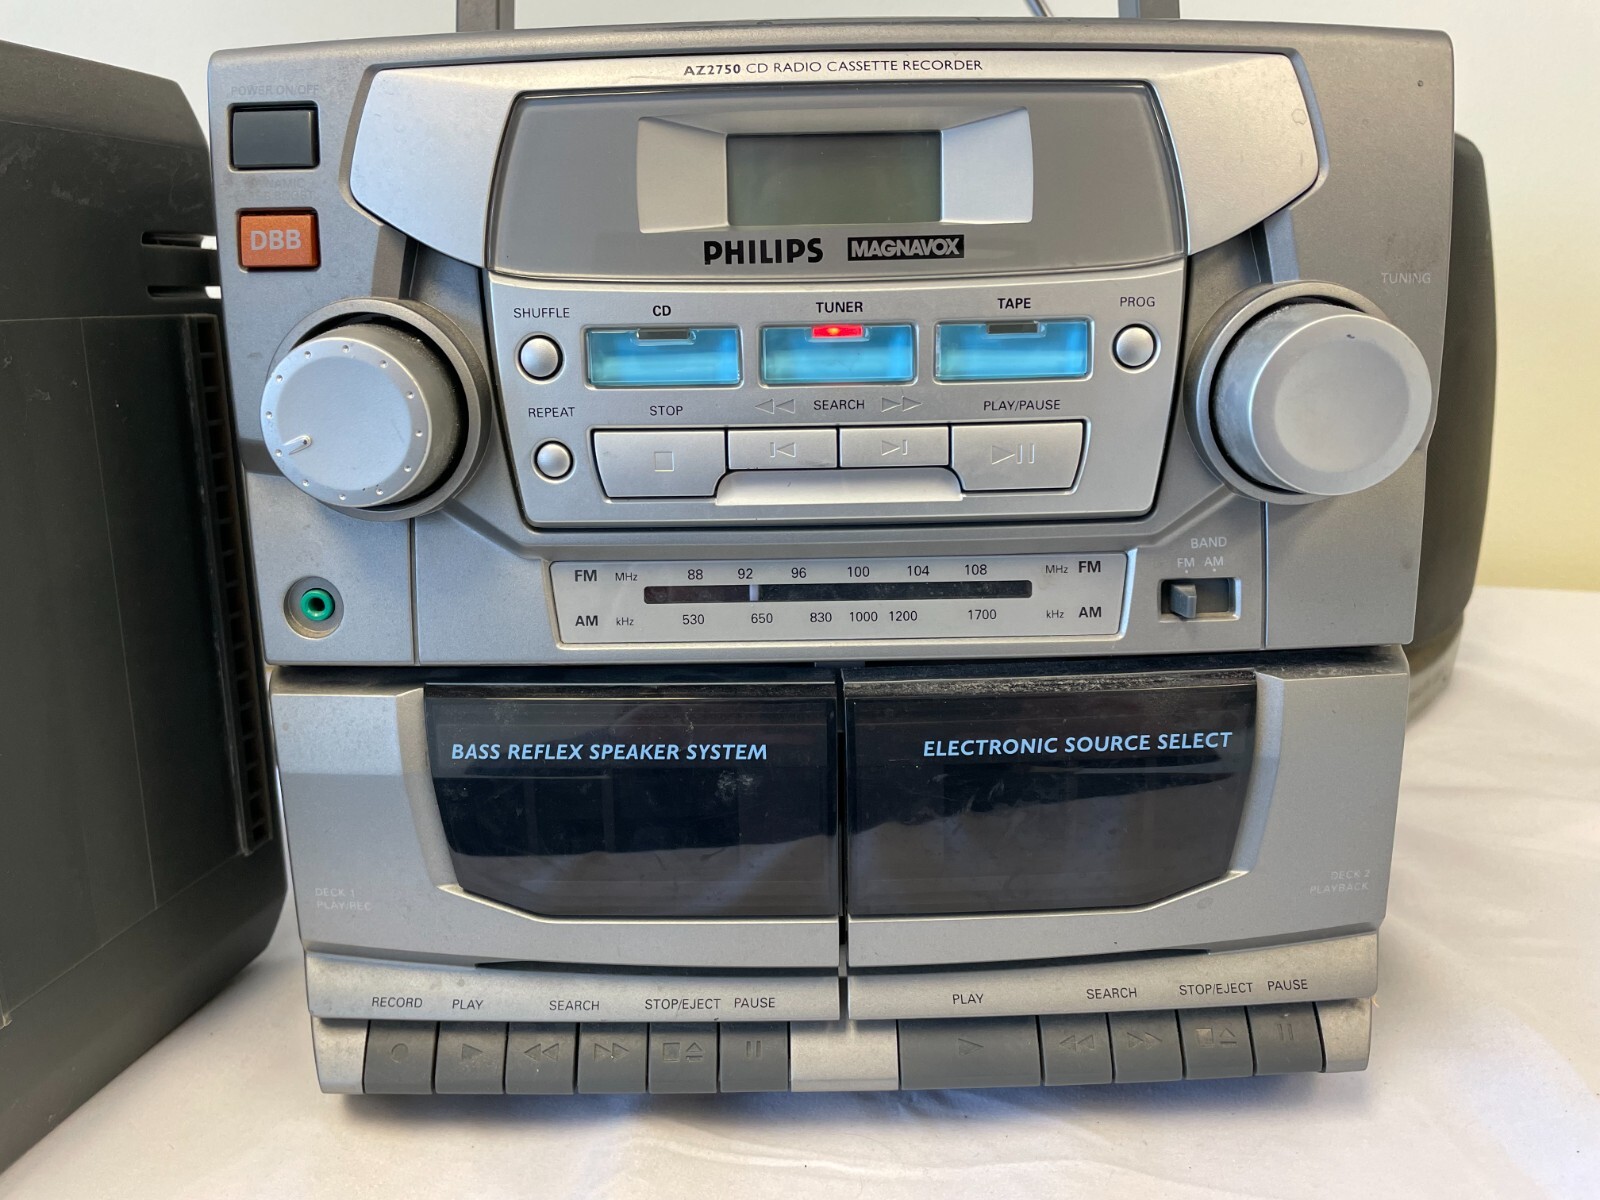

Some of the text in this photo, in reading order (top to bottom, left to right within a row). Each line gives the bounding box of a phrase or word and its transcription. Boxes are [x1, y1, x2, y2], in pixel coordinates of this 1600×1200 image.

[683, 59, 983, 76] AZ2750 CD RADIO CASSETTE RECORDER
[231, 85, 272, 96] POWER
[250, 178, 305, 190] NAMIC
[250, 230, 302, 251] DBB
[704, 238, 824, 265] PHILIPS
[850, 236, 962, 259] MAGNAVOX
[1381, 272, 1431, 284] TUNING
[816, 301, 863, 313] TUNER
[997, 298, 1031, 310] TAPE
[1119, 296, 1156, 308] PROG
[513, 307, 570, 319] SHUFFLE
[652, 305, 672, 317] CD
[649, 405, 683, 416] STOP
[813, 399, 865, 411] SEARCH
[983, 399, 1061, 412] PLAY/PAUSE
[528, 406, 575, 418] REPEAT
[1190, 536, 1227, 549] BAND
[1177, 556, 1224, 568] FM AM
[574, 560, 1101, 582] FM MHz 88 92 96 100 104 108 MHz FM
[575, 607, 1102, 627] AM kHz 530 650 830 1000 1200 1700 kHz AM
[923, 731, 1233, 757] ELECTRONIC SOURCE SELECT
[451, 744, 768, 760] BASS REFLEX SPEAKER SYSTEM
[1331, 869, 1371, 880] DECK 2
[314, 887, 355, 898] DECK 1
[1309, 882, 1369, 894] PLAYBACK
[316, 900, 372, 911] PLAY/REC
[1179, 982, 1254, 996] STOP/EJECT
[1267, 979, 1309, 991] PAUSE
[952, 993, 984, 1005] PLAY
[1086, 987, 1138, 1000] SEARCH
[371, 997, 423, 1009] RECORD
[452, 999, 484, 1010] PLAY
[549, 1000, 600, 1012] SEARCH
[644, 998, 721, 1010] STOP/EJECT
[733, 997, 776, 1009] PAUSE
